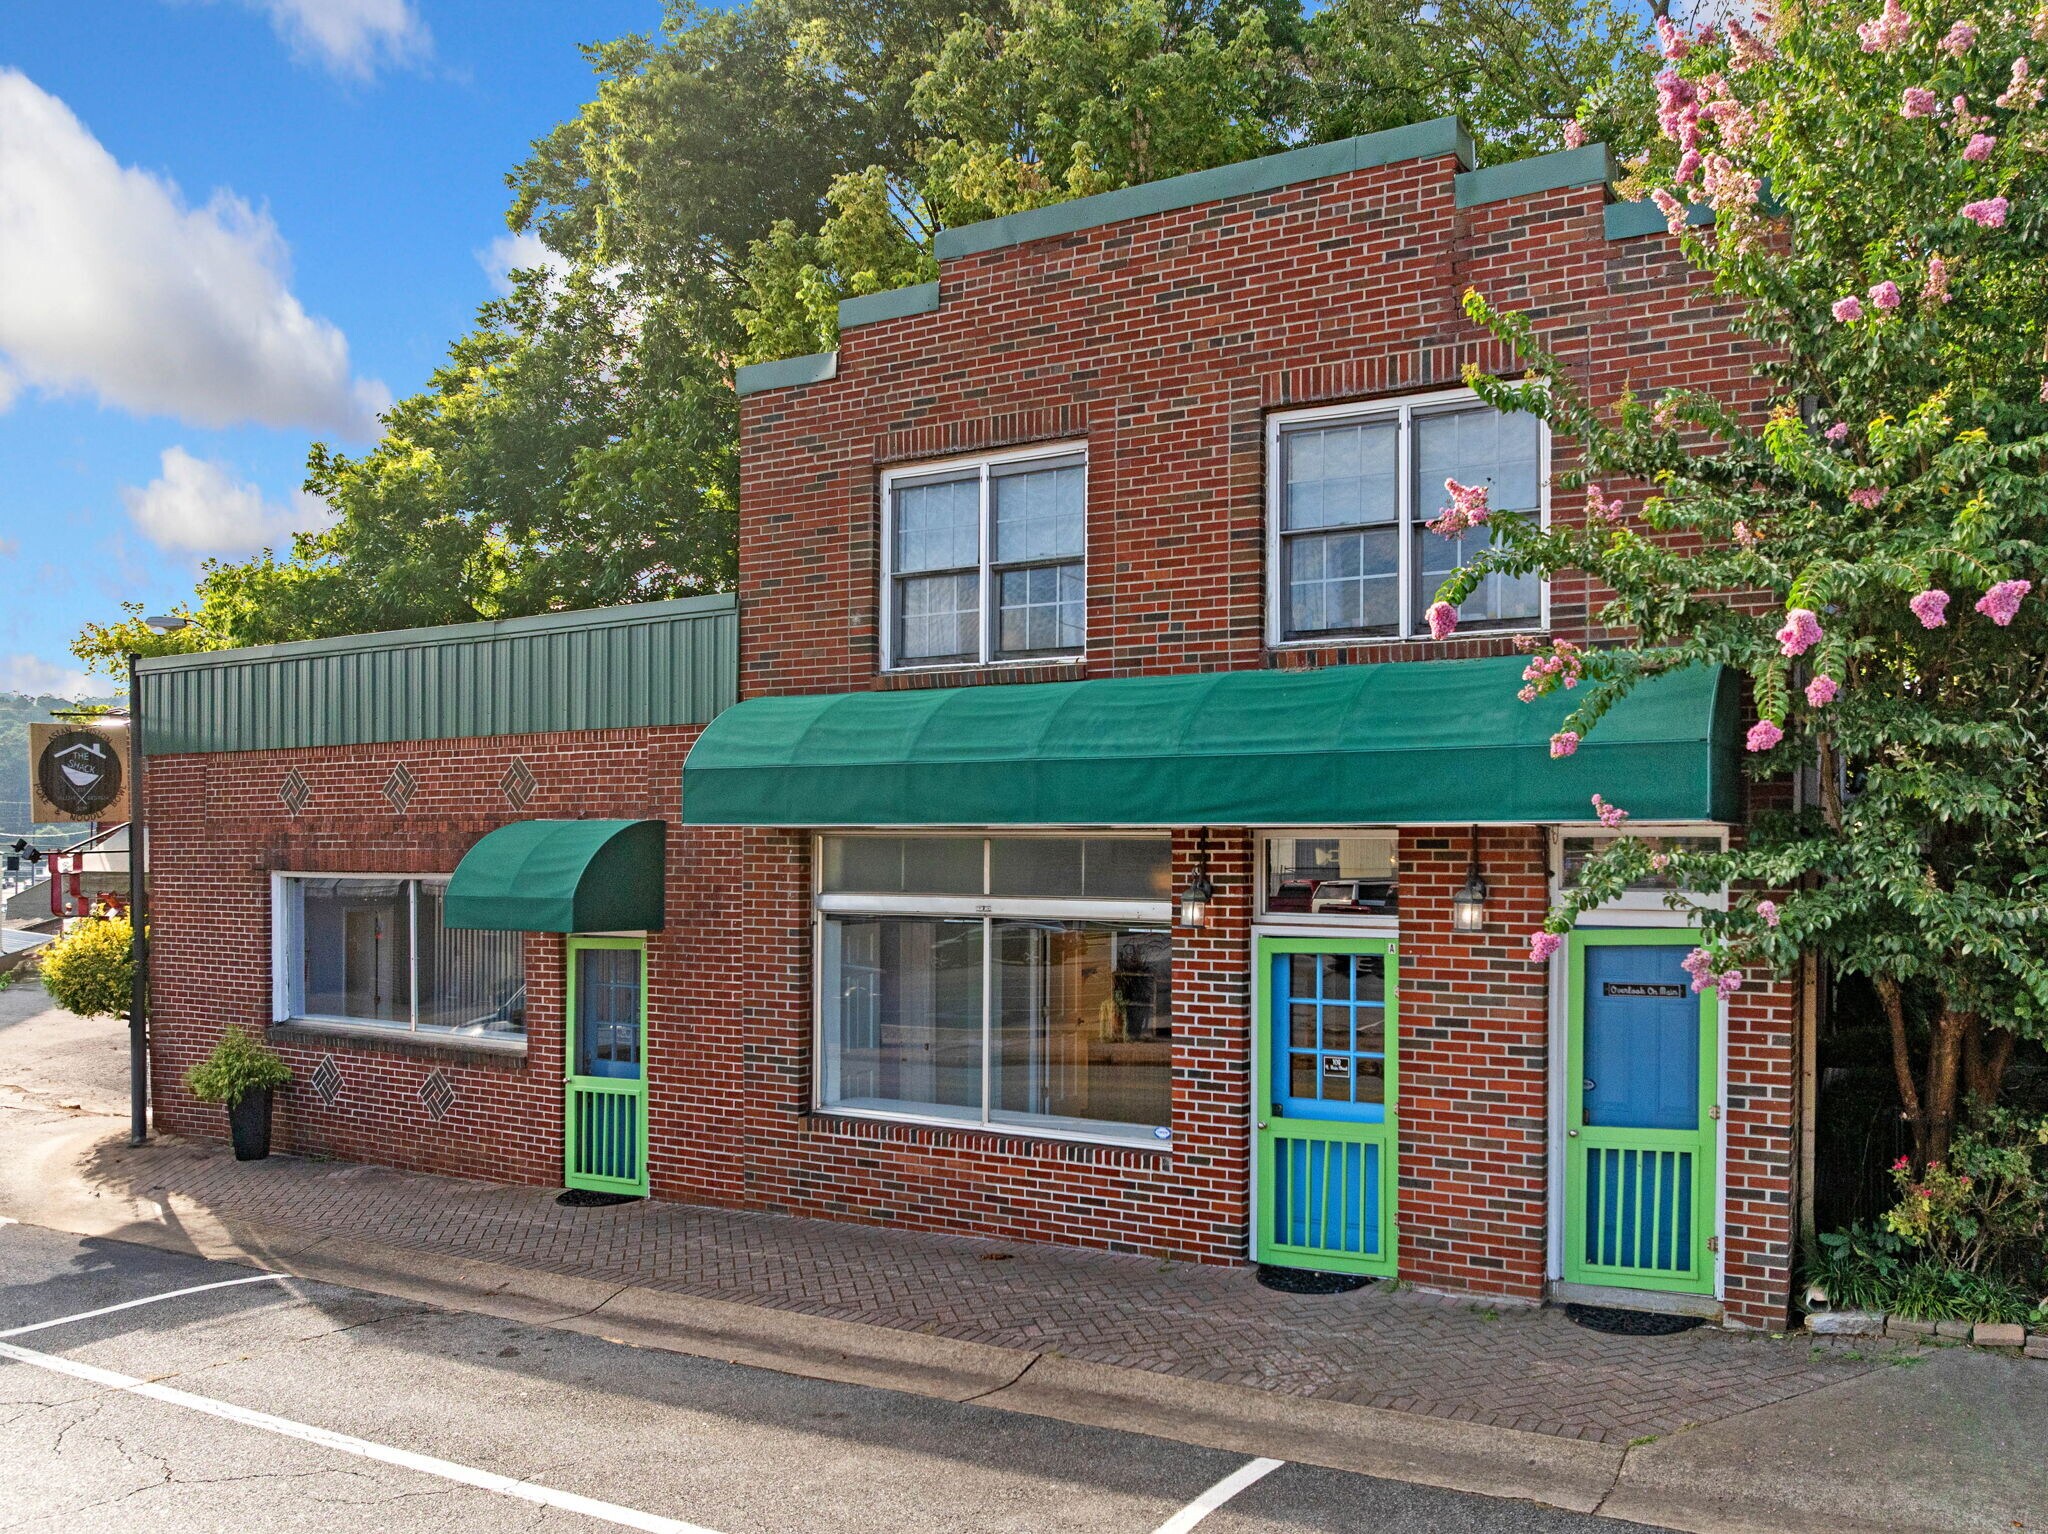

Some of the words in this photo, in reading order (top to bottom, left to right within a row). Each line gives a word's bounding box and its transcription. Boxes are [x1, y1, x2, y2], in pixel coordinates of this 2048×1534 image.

[73, 751, 89, 760] THE
[69, 809, 106, 822] NOODLE
[111, 785, 127, 808] BOWL
[1610, 985, 1646, 995] Overlook
[1647, 986, 1658, 995] On
[1659, 986, 1678, 996] Main
